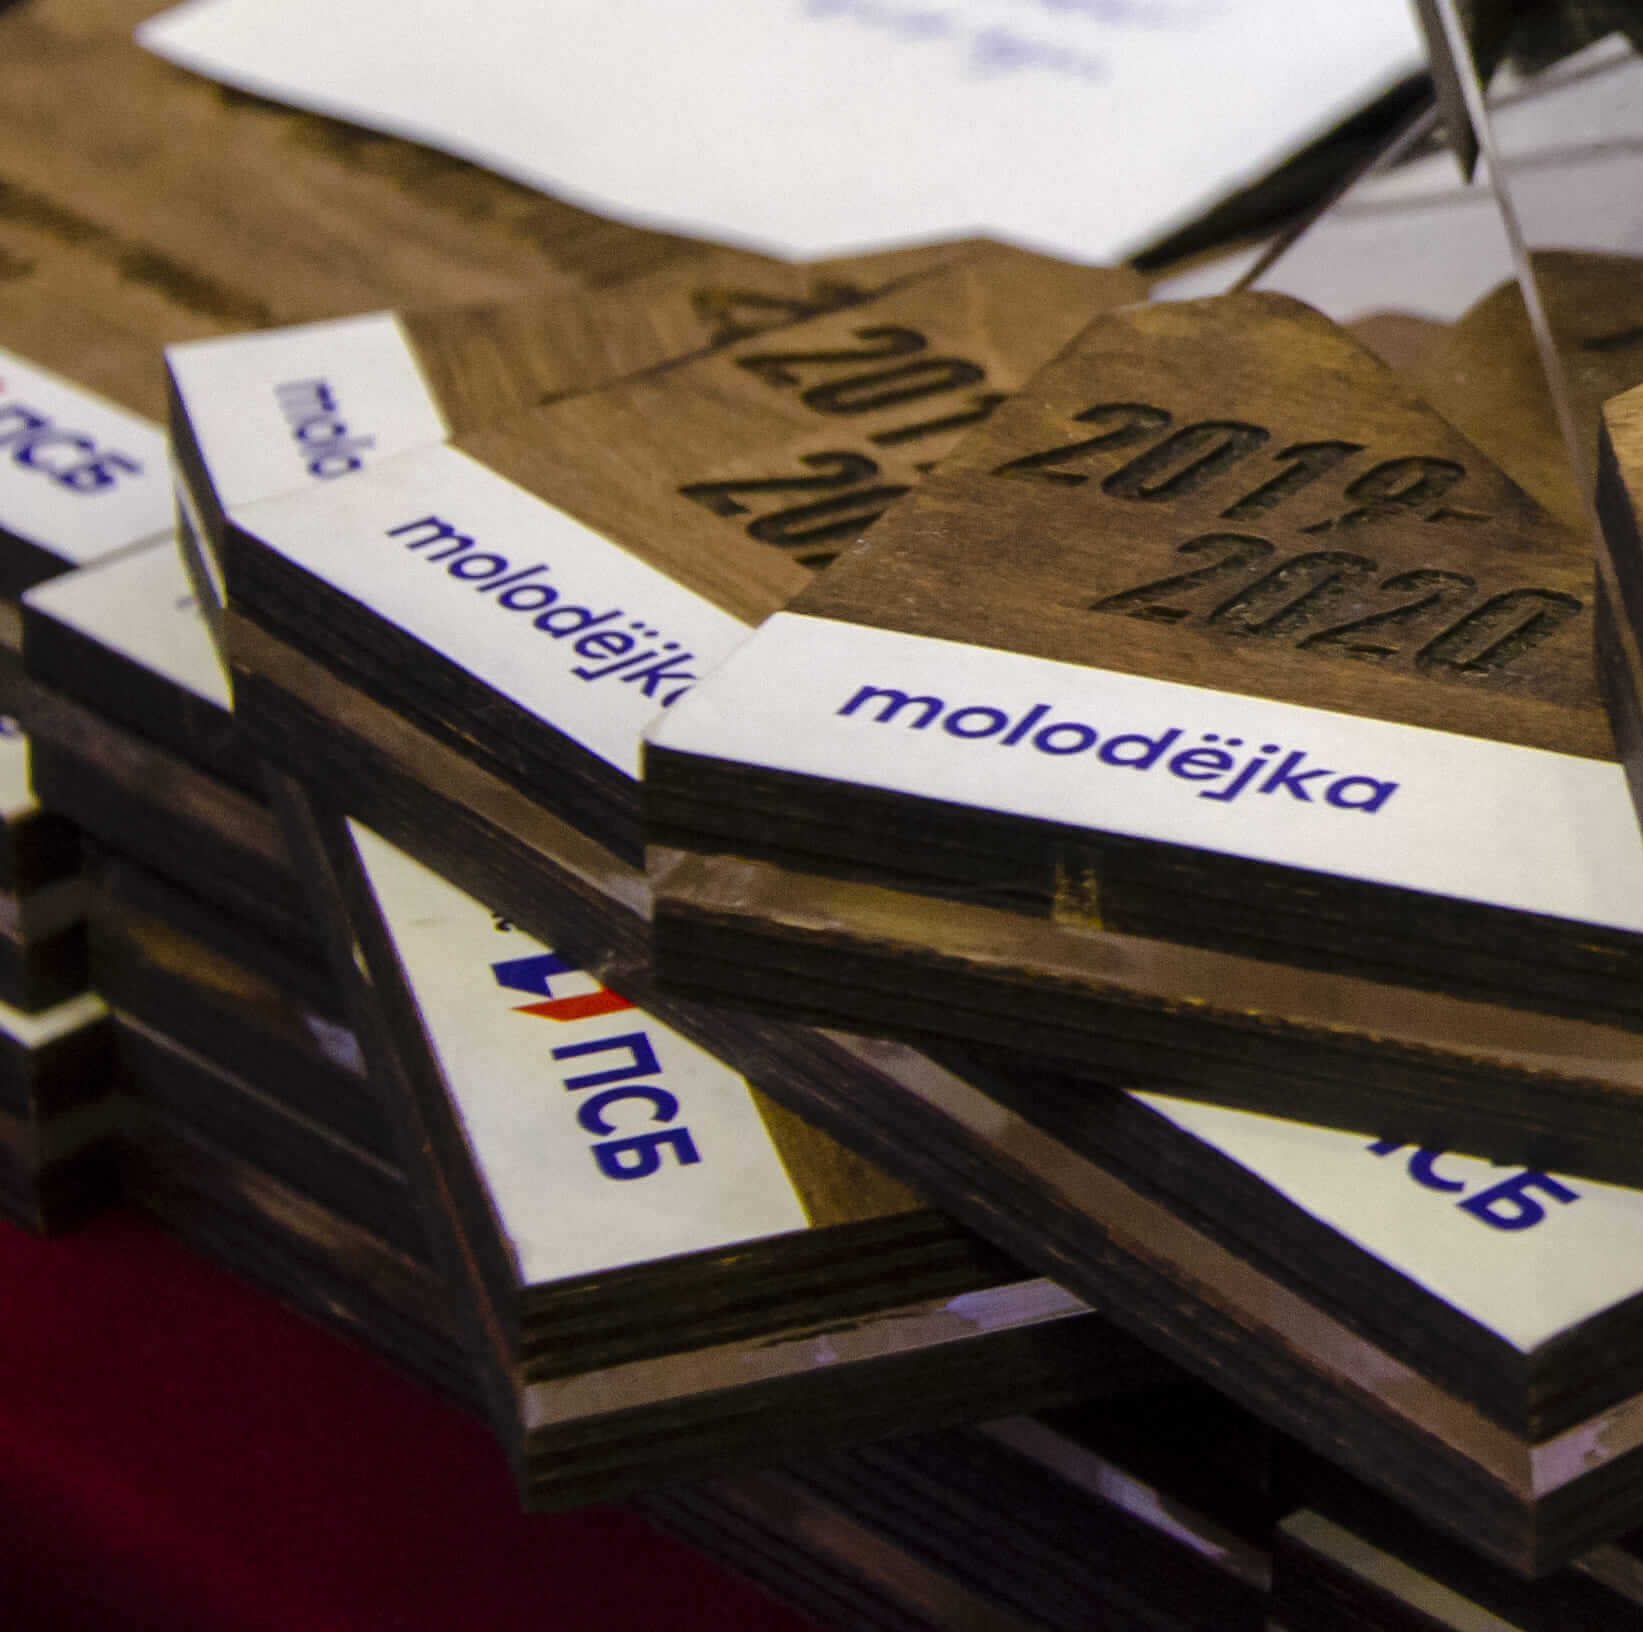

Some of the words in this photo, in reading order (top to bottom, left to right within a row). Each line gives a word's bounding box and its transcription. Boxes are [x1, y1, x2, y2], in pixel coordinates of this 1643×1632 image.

[735, 325, 1012, 475] 201
[988, 401, 1492, 535] 2019-
[385, 515, 699, 709] molodëjk
[1090, 531, 1584, 679] 2020
[836, 682, 1402, 815] molodëjka
[550, 1031, 702, 1182] ПСБ
[1364, 1140, 1583, 1231] СБ
